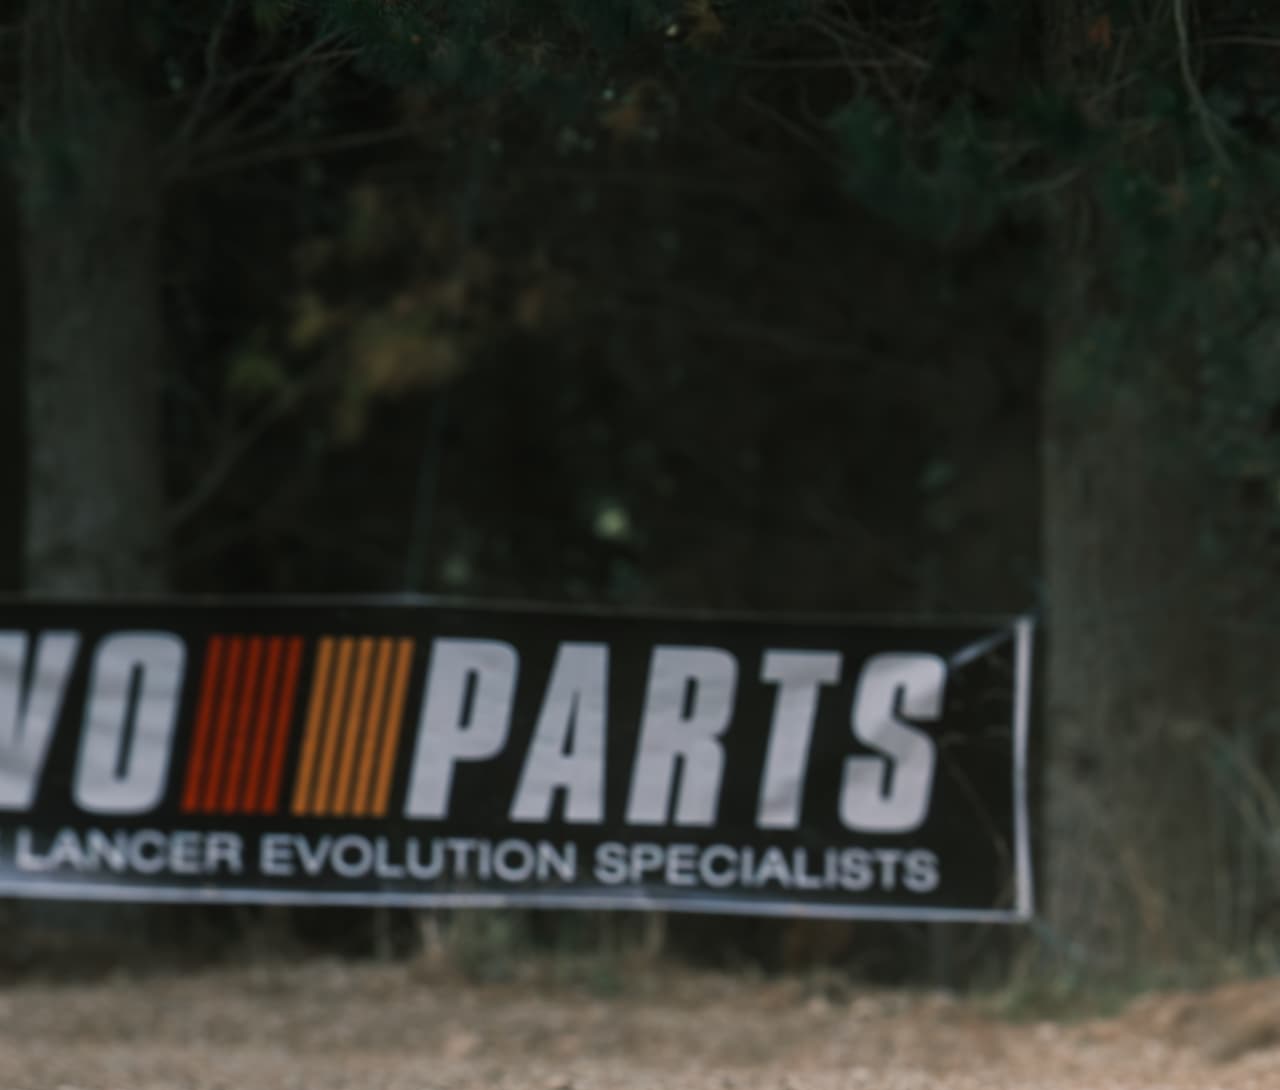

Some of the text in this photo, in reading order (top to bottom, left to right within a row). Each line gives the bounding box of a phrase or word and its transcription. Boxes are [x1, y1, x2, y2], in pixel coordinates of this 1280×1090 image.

[404, 637, 947, 834] PARTS
[15, 827, 941, 892] LANCER EVOLUTION SPECIALISTS
